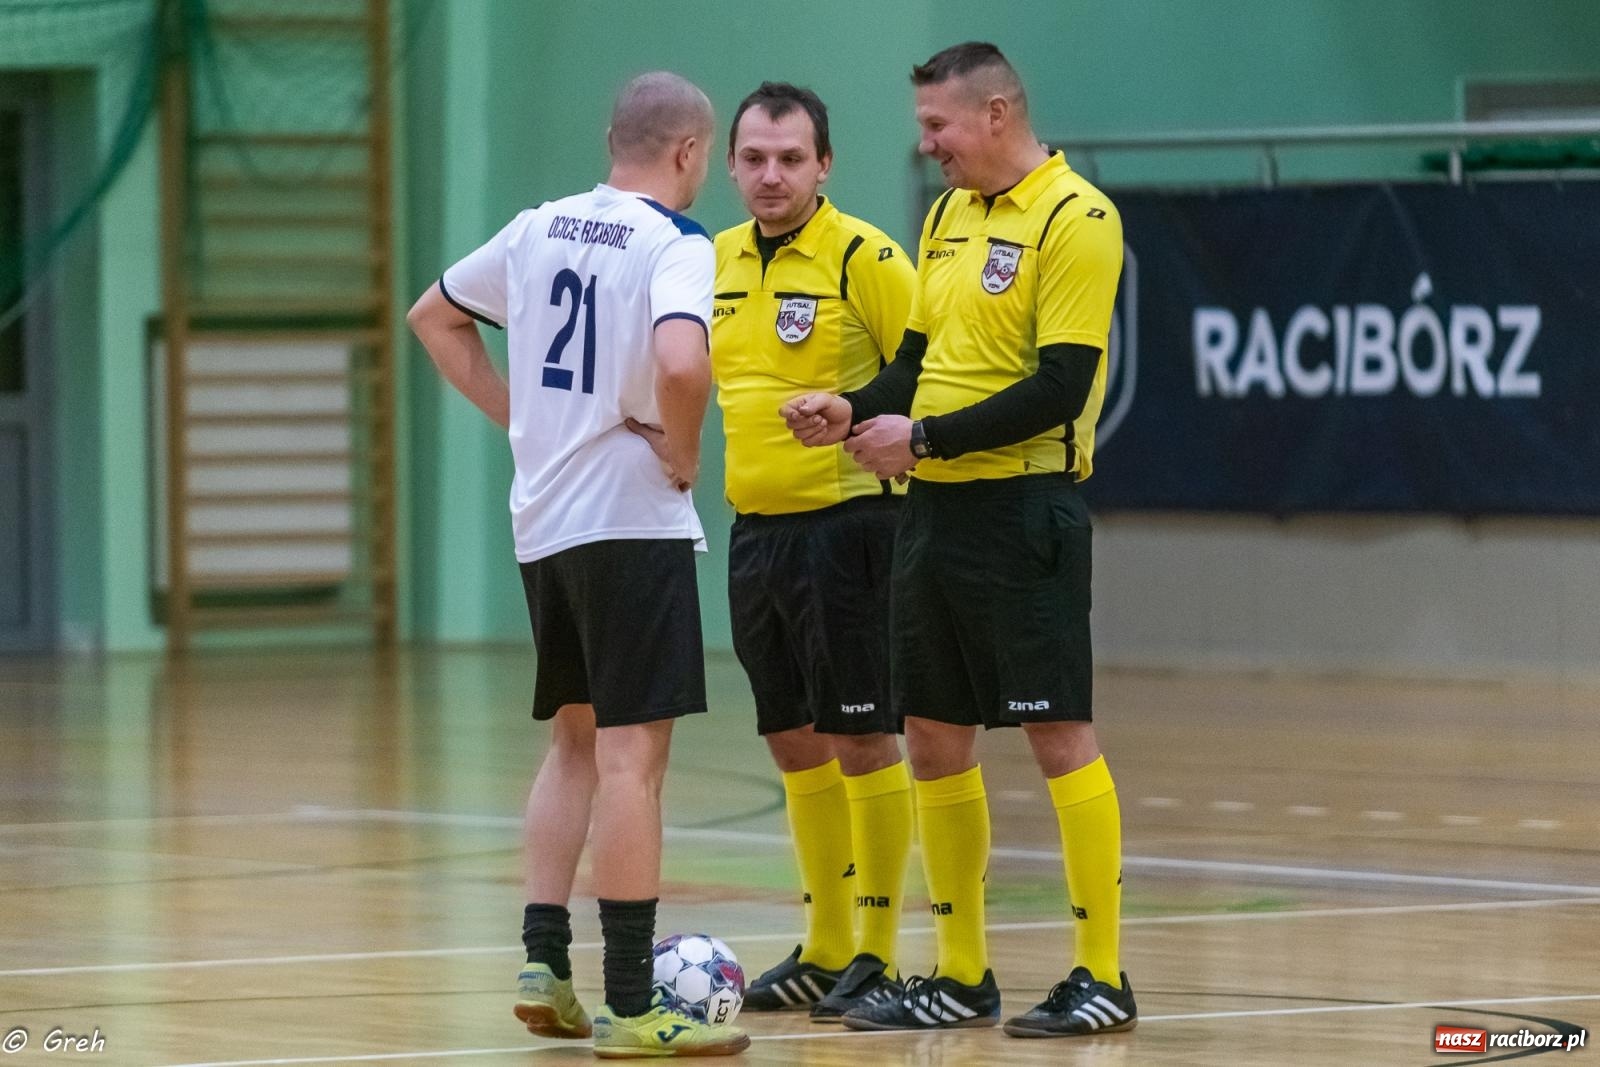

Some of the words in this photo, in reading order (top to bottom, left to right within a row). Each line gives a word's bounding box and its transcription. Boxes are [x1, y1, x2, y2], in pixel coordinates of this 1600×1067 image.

[547, 215, 581, 241] OCICE
[713, 306, 736, 317] ina
[541, 267, 597, 395] 21
[1193, 271, 1542, 398] RACIBÓRZ
[1007, 700, 1050, 711] zina
[931, 902, 953, 915] na
[714, 998, 730, 1024] ECT
